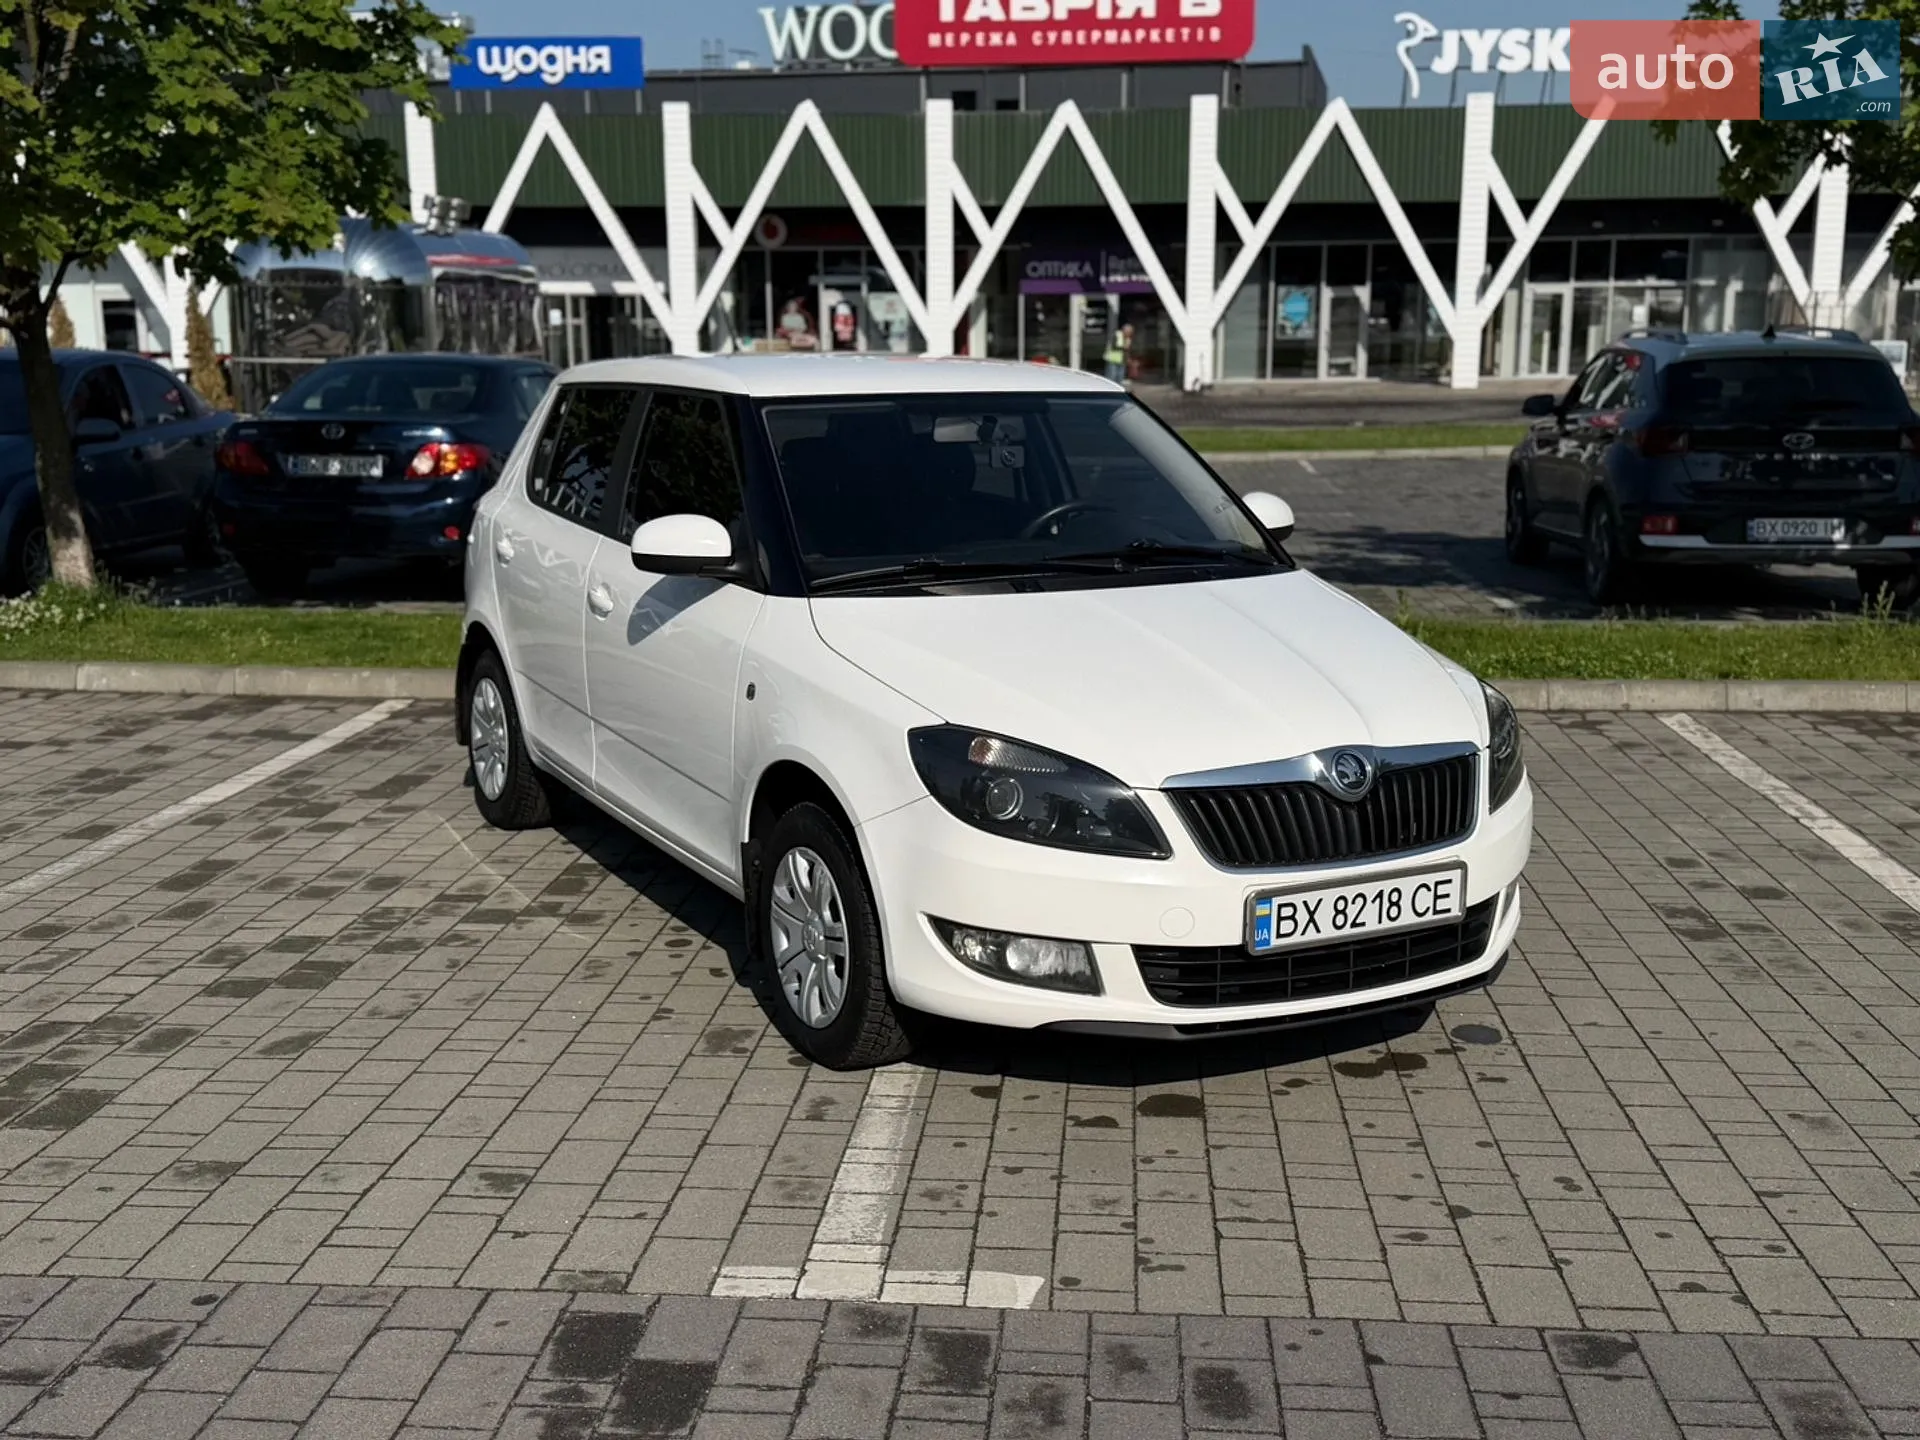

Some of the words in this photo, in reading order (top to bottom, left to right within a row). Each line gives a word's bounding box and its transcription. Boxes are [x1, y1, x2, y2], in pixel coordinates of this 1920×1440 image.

[928, 31, 1017, 48] МЕРЕЖА
[1031, 26, 1221, 46] СУПЕРМАРКЕТІВ
[1430, 27, 1571, 74] JYSK
[1756, 520, 1778, 536] BX
[1781, 520, 1818, 536] 0920
[1275, 898, 1323, 939] BX
[1332, 886, 1402, 931] 8218
[1411, 878, 1452, 918] CE
[1254, 928, 1269, 942] UA
